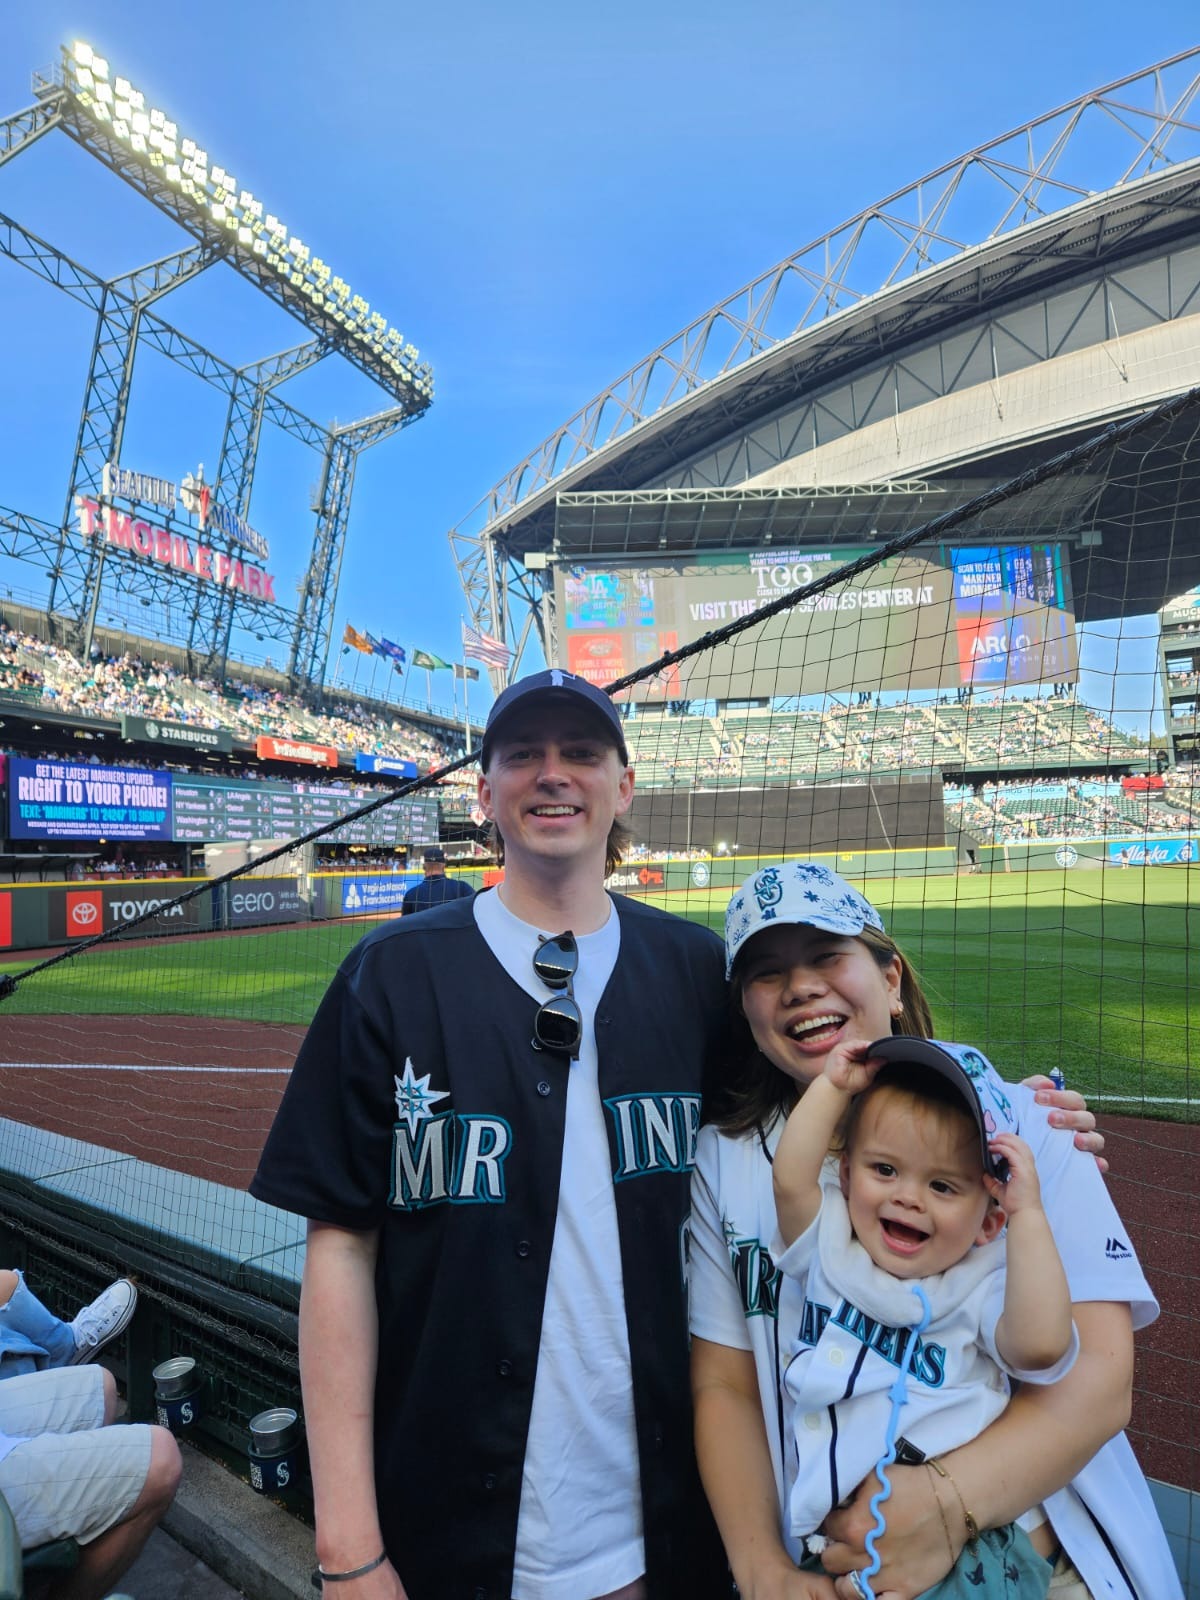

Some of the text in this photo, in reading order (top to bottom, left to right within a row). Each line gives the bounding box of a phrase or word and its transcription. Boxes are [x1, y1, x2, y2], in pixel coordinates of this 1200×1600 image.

[105, 463, 176, 510] SEATTLE
[210, 502, 269, 561] MARINERS
[77, 496, 276, 602] T-MOBILE PARK
[750, 563, 814, 588] TOO
[689, 601, 727, 621] VISIT
[728, 599, 757, 618] THE
[799, 590, 858, 613] SERVICES
[858, 587, 914, 608] CENTER
[915, 586, 934, 604] AT
[1172, 608, 1200, 618] MUC
[161, 726, 219, 746] STARBUCKS
[36, 764, 154, 786] GET THE LATEST MARINERS UPDATES
[18, 776, 168, 808] RIGHT TO YOUR PHONE!
[90, 808, 99, 821] TO
[128, 810, 138, 822] TO
[1114, 844, 1169, 862] Alaka
[605, 872, 639, 889] yBank
[109, 898, 184, 920] TOYOTA
[232, 891, 274, 914] eero
[603, 1092, 702, 1183] INE
